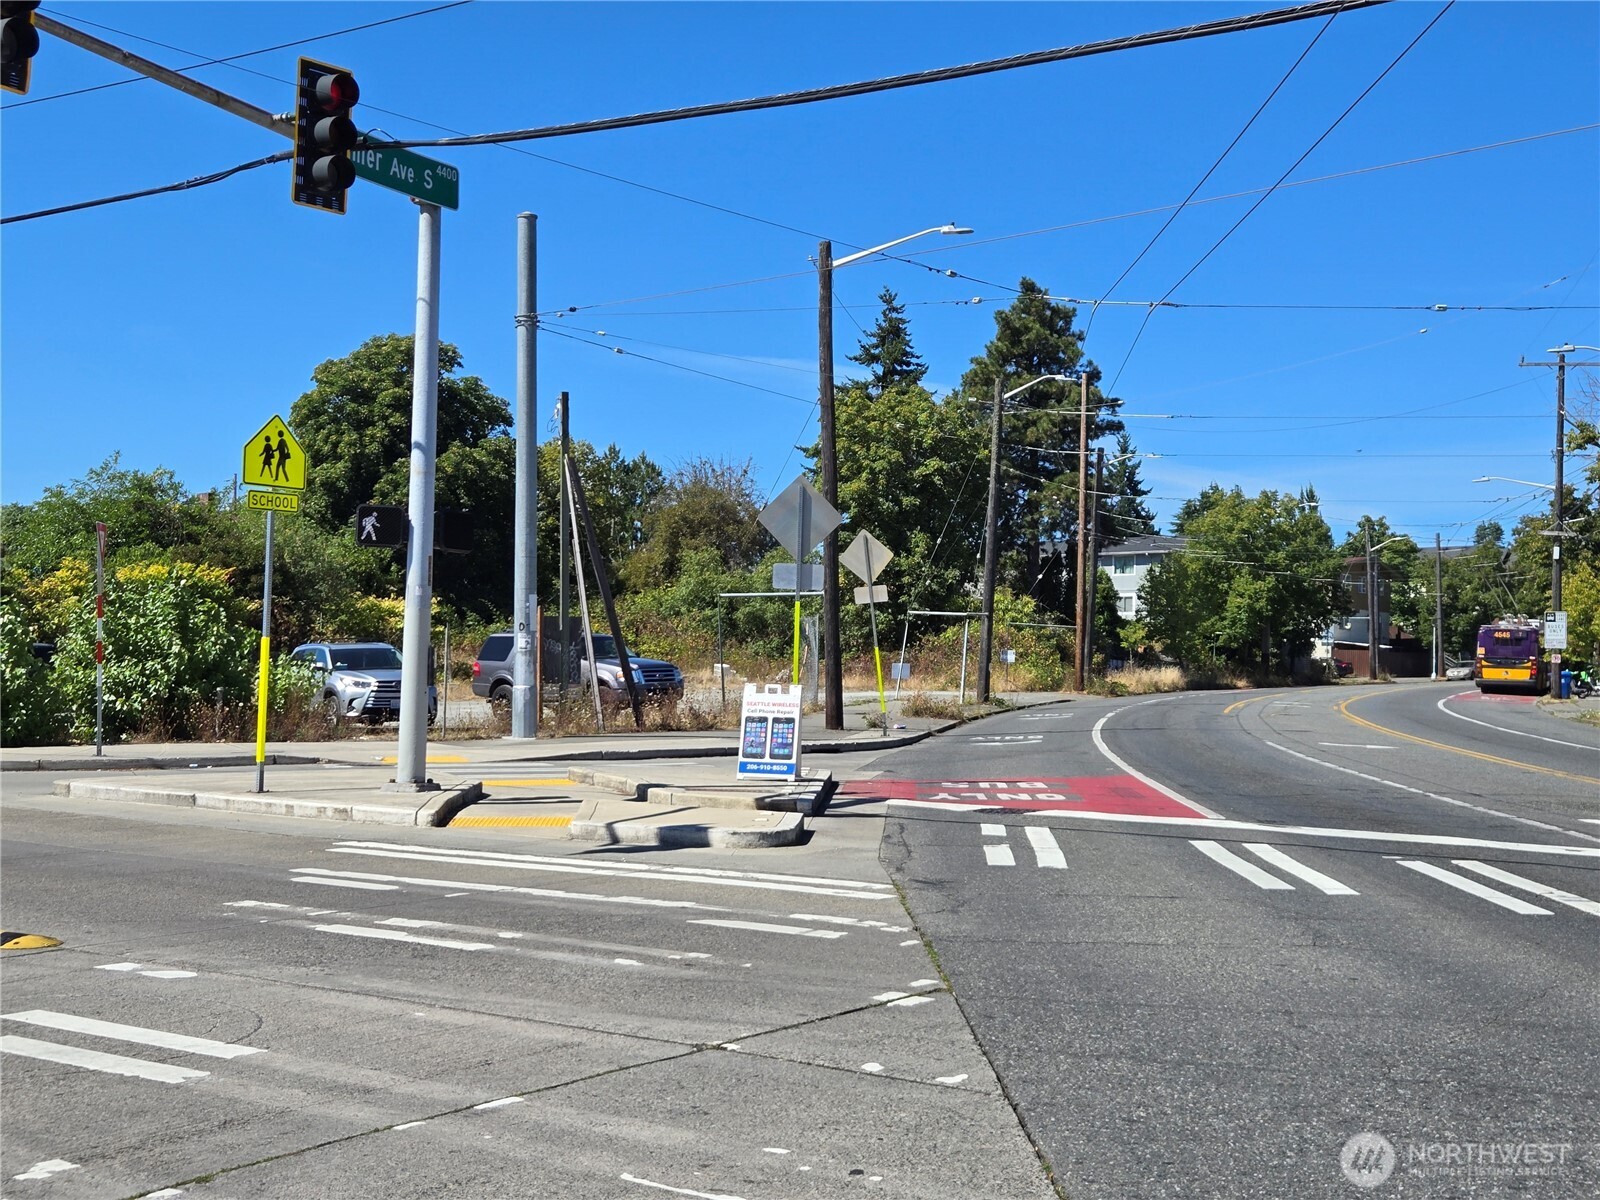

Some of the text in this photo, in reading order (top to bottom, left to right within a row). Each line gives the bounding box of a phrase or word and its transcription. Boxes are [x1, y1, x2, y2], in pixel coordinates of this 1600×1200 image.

[424, 169, 433, 189] S
[436, 165, 457, 182] 4400
[251, 494, 296, 509] SCHOOL
[941, 781, 1048, 789] BUS
[929, 792, 1066, 801] ONLY
